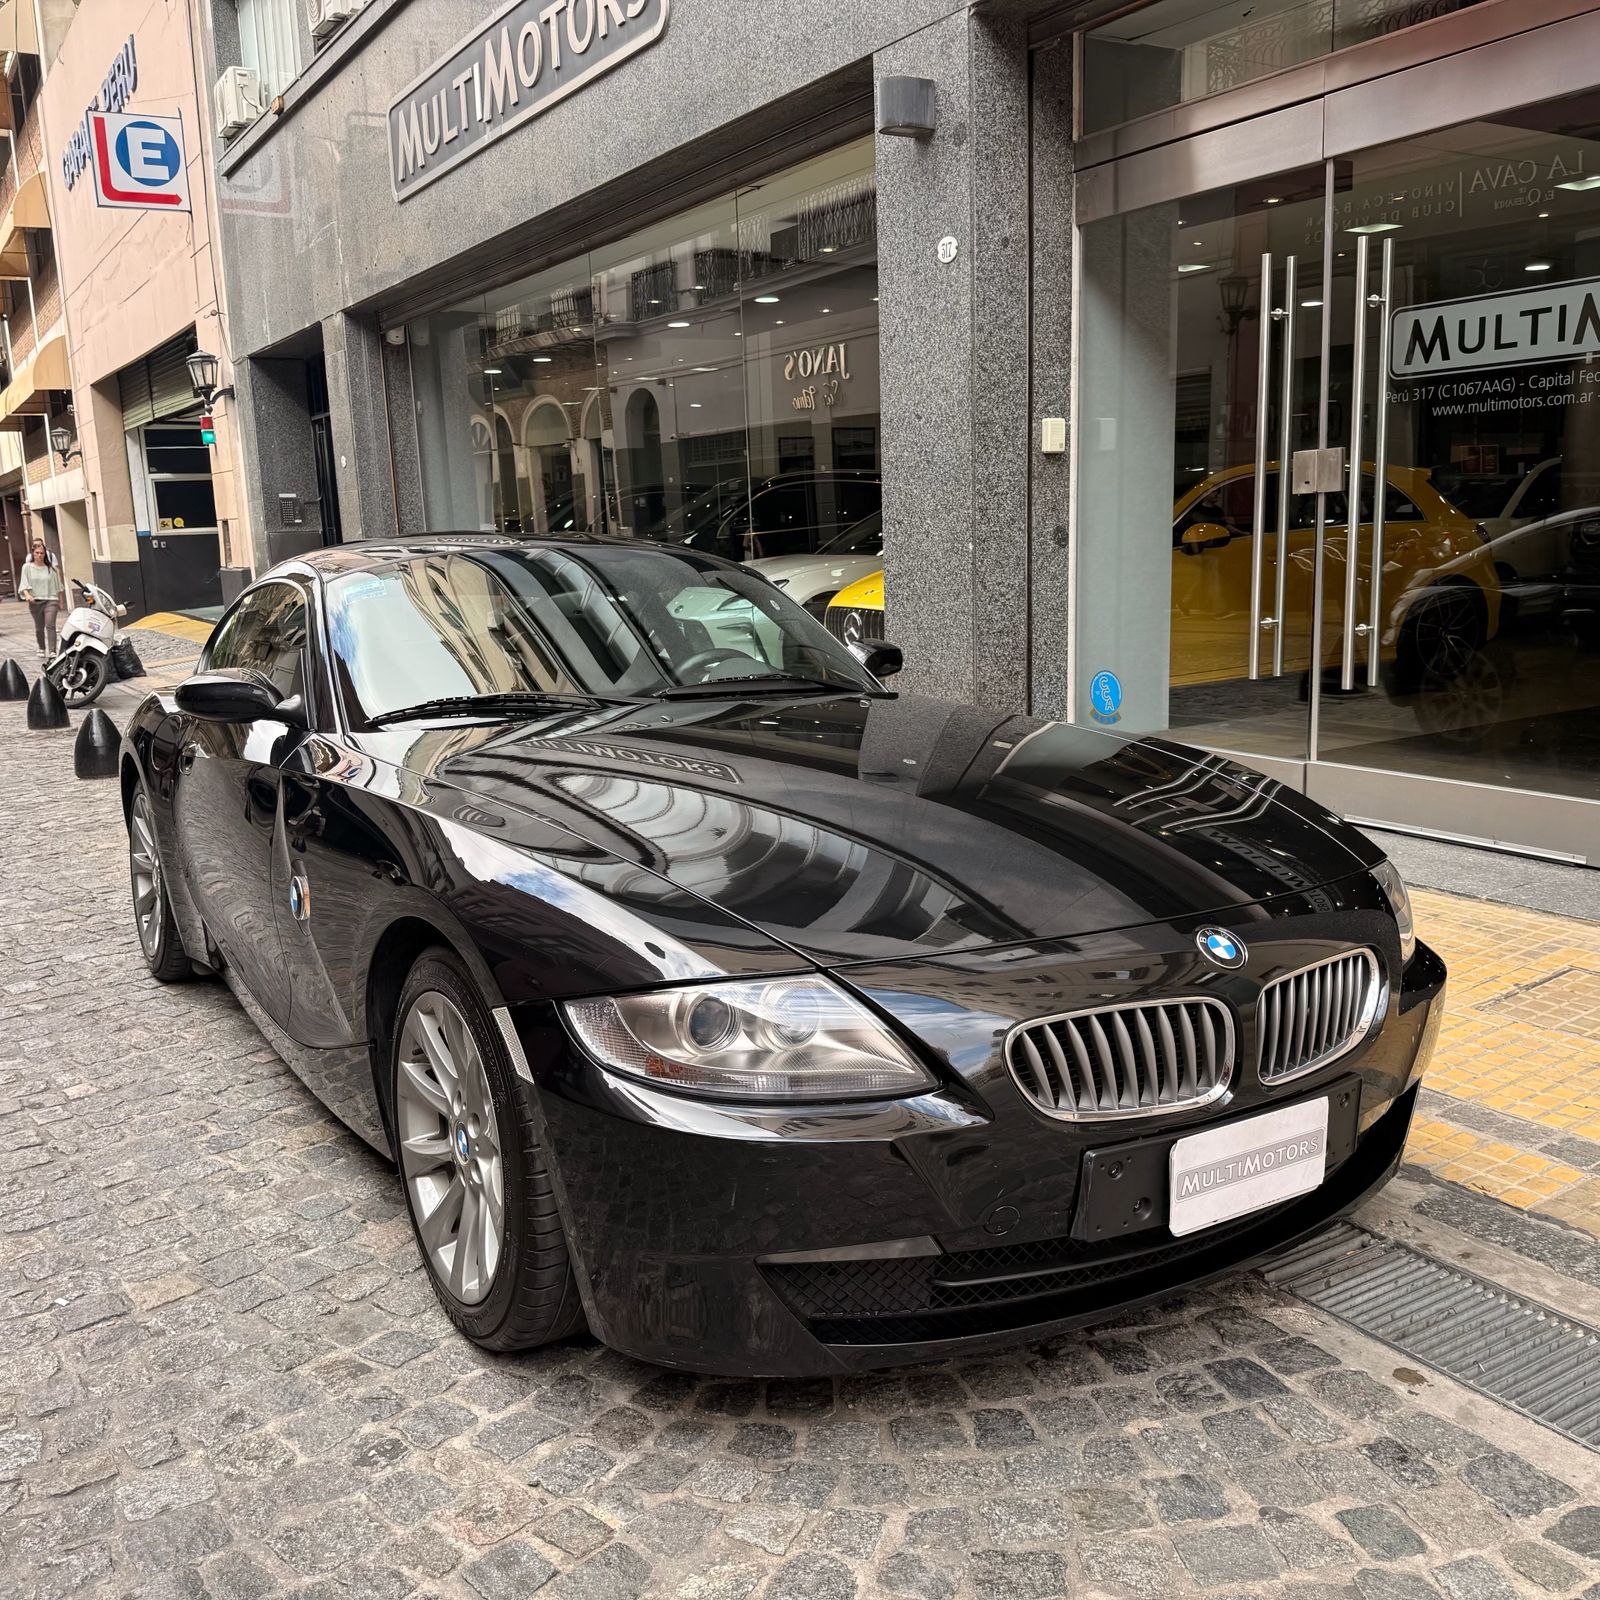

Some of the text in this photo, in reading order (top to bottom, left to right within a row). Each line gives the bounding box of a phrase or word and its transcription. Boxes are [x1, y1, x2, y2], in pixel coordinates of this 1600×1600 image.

[126, 127, 170, 181] E
[1385, 390, 1409, 404] Perú
[1413, 387, 1435, 401] 317
[1438, 377, 1516, 400] (C1067AAG)
[1529, 370, 1575, 391] Capital
[1432, 391, 1594, 417] www.multimotors.com.ar
[1181, 1136, 1319, 1197] MULTIMOTORS
